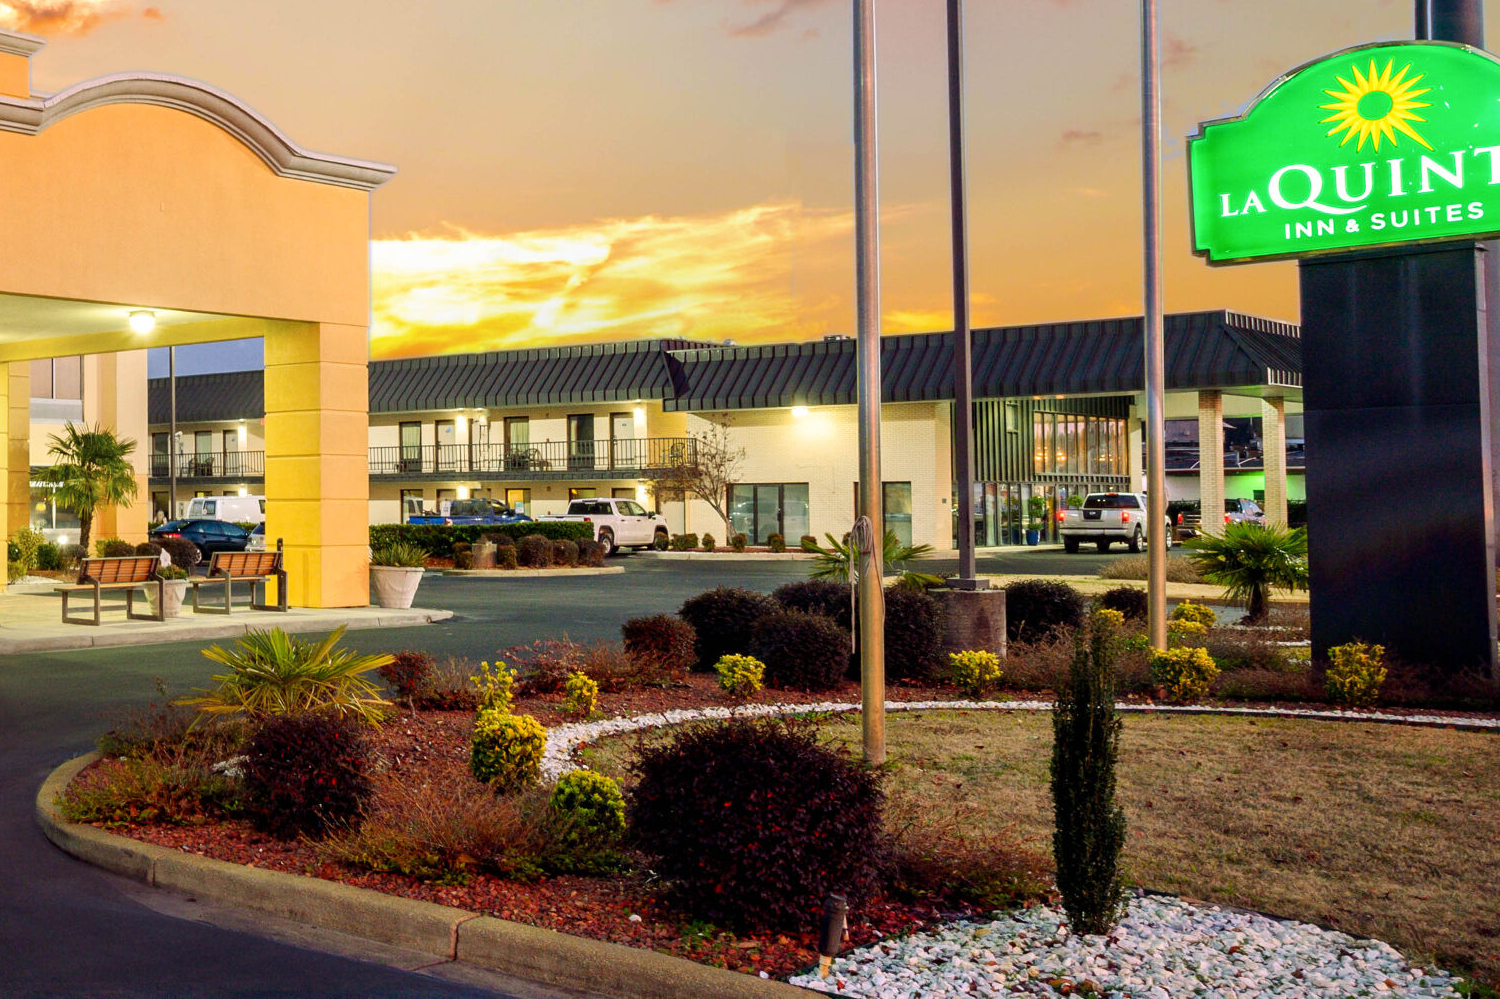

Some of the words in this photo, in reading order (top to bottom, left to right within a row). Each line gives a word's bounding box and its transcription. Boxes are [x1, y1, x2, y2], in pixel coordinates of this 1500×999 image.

[1220, 190, 1267, 217] LA
[1268, 146, 1500, 214] QUINT
[1285, 219, 1334, 239] INN
[1345, 219, 1359, 233] &
[1371, 202, 1484, 230] SUITES
